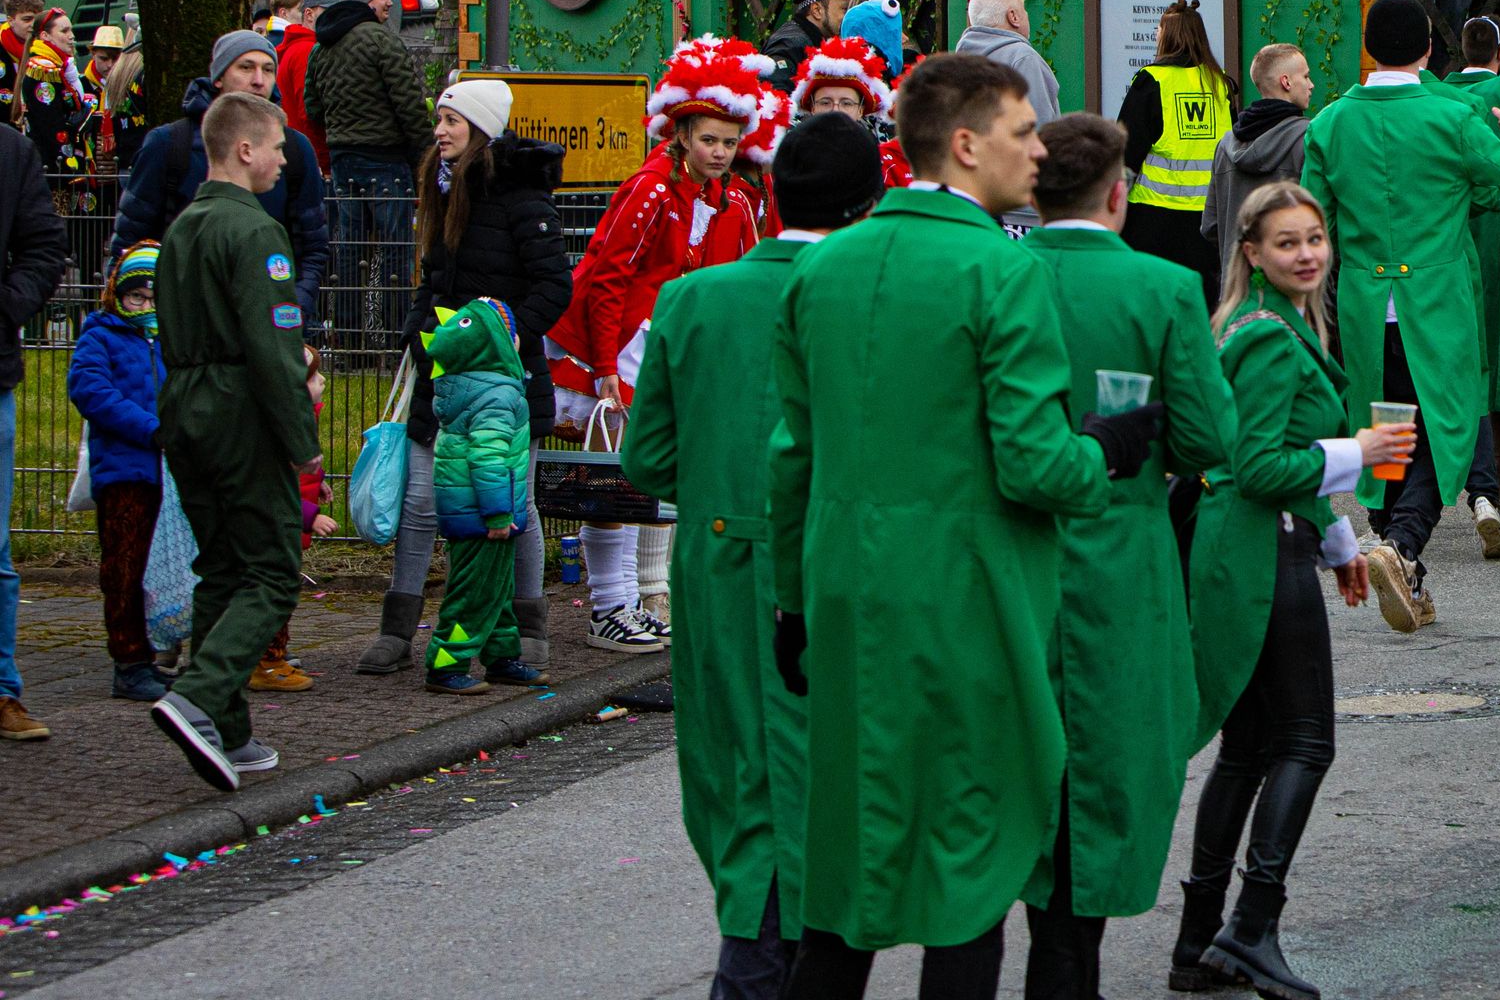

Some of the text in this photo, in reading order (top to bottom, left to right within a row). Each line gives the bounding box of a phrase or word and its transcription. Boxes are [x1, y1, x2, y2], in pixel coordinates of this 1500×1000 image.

[1184, 102, 1206, 122] W
[510, 117, 628, 158] üttingen 3 km
